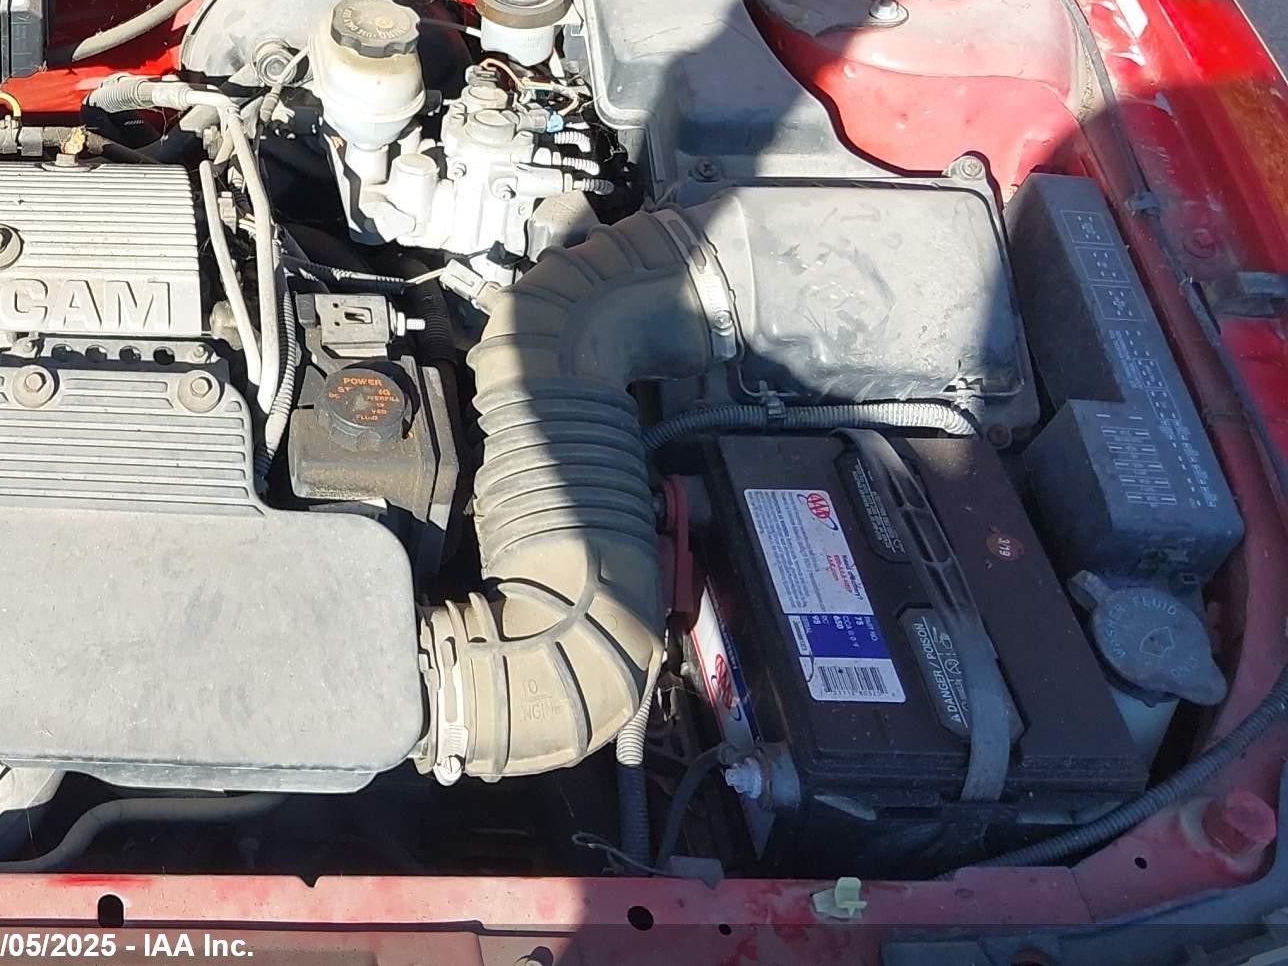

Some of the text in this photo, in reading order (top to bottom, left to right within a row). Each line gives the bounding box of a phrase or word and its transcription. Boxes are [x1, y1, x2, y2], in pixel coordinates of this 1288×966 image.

[343, 377, 383, 386] POWER
[1132, 596, 1177, 616] FLUID
[913, 623, 937, 659] POISON
[934, 670, 957, 711] DANGER
